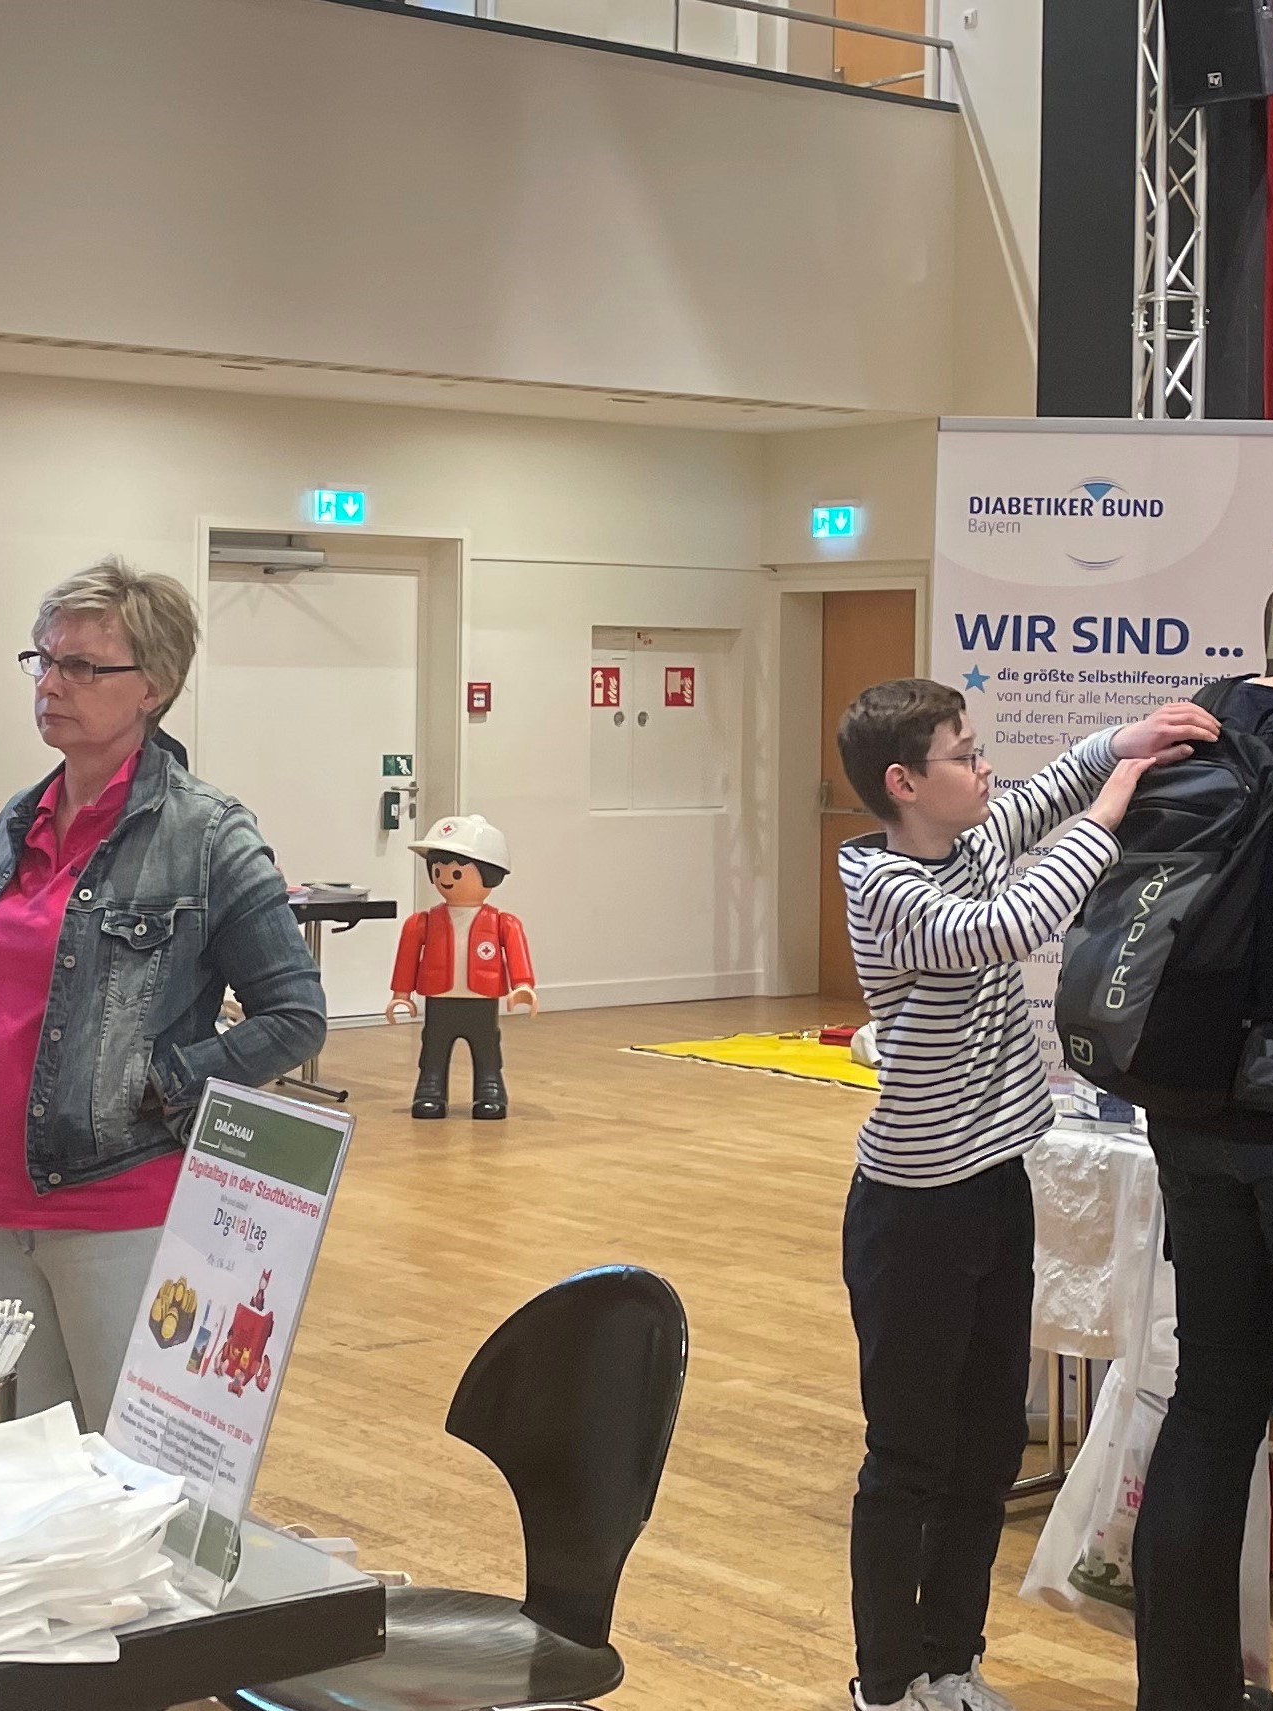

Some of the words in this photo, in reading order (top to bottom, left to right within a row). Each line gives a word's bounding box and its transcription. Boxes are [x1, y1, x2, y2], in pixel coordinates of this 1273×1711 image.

[969, 496, 1094, 516] DIABETIKER
[1102, 498, 1164, 518] BUND
[968, 518, 1021, 536] Bayern
[954, 612, 1058, 653] WIR
[1072, 616, 1190, 656] SIND
[997, 667, 1019, 681] die
[1023, 669, 1075, 687] größte
[1078, 670, 1230, 688] Selbsthilfeorganisa
[996, 691, 1022, 702] von
[1026, 690, 1051, 703] und
[1055, 690, 1075, 704] für
[1078, 691, 1101, 705] alle
[1104, 692, 1174, 706] Menschen
[996, 711, 1022, 724] und
[1028, 711, 1064, 724] deren
[1068, 712, 1123, 726] Familien
[1105, 863, 1175, 1009] ORTOVOX
[214, 1117, 255, 1142] DACHAU
[187, 1155, 228, 1188] Digitaltag
[230, 1171, 239, 1187] in
[239, 1175, 256, 1194] der
[255, 1180, 321, 1220] Stadtbücherei
[213, 1207, 267, 1250] Digitaltag
